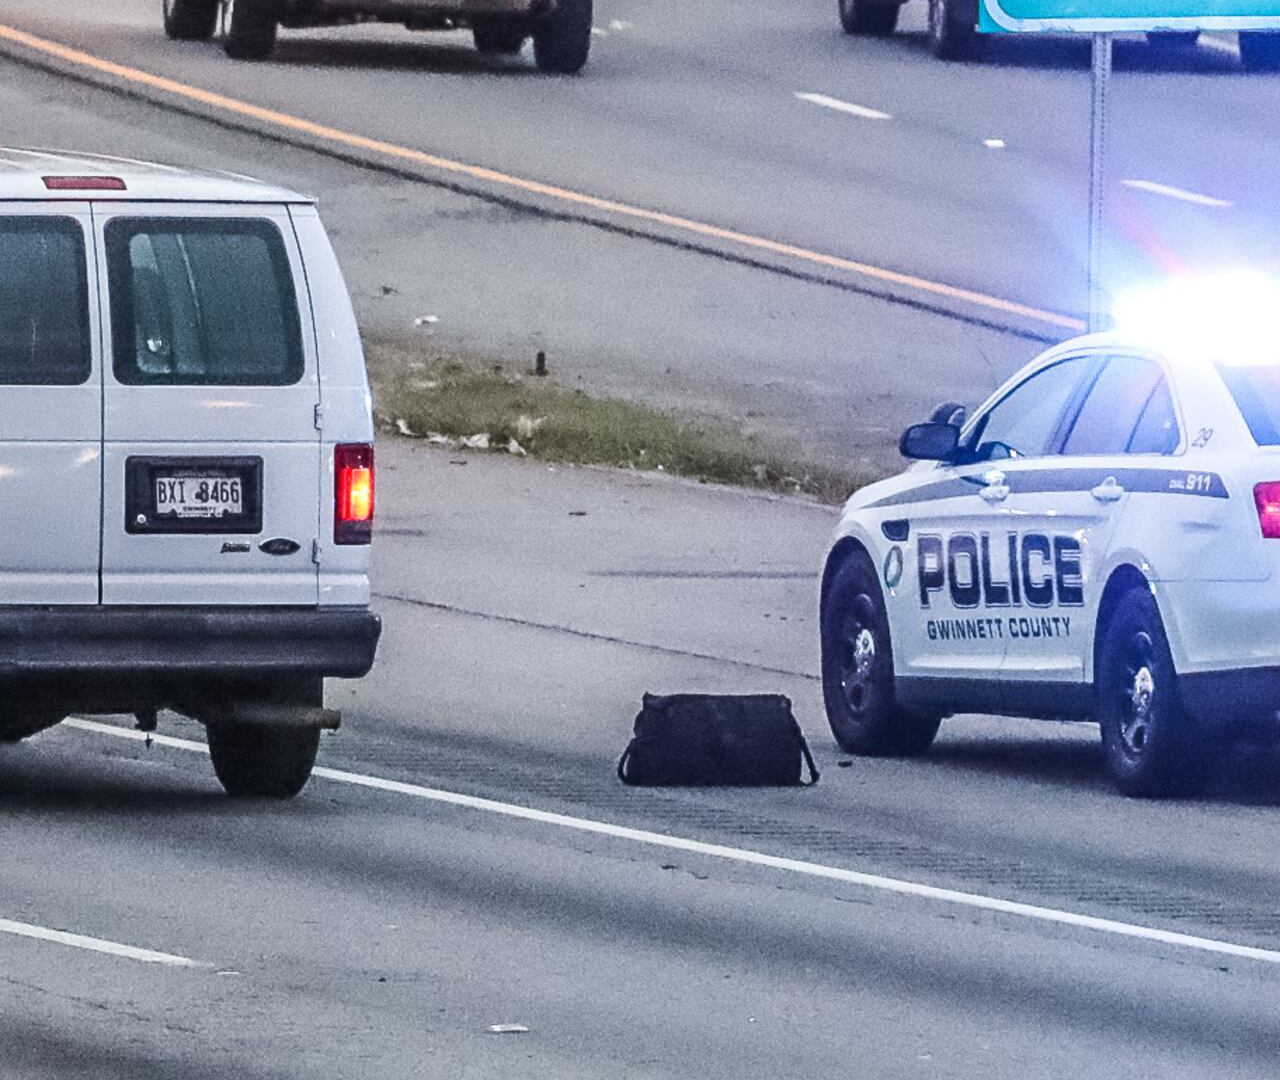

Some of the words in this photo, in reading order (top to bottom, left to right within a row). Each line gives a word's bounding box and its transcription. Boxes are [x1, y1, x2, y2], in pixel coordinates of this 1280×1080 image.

[158, 480, 185, 504] BXI
[199, 481, 239, 504] 8466
[1186, 474, 1211, 491] 911
[917, 531, 1085, 610] POLICE
[927, 619, 1003, 640] GWINNETT
[1008, 617, 1071, 638] COUNTY
